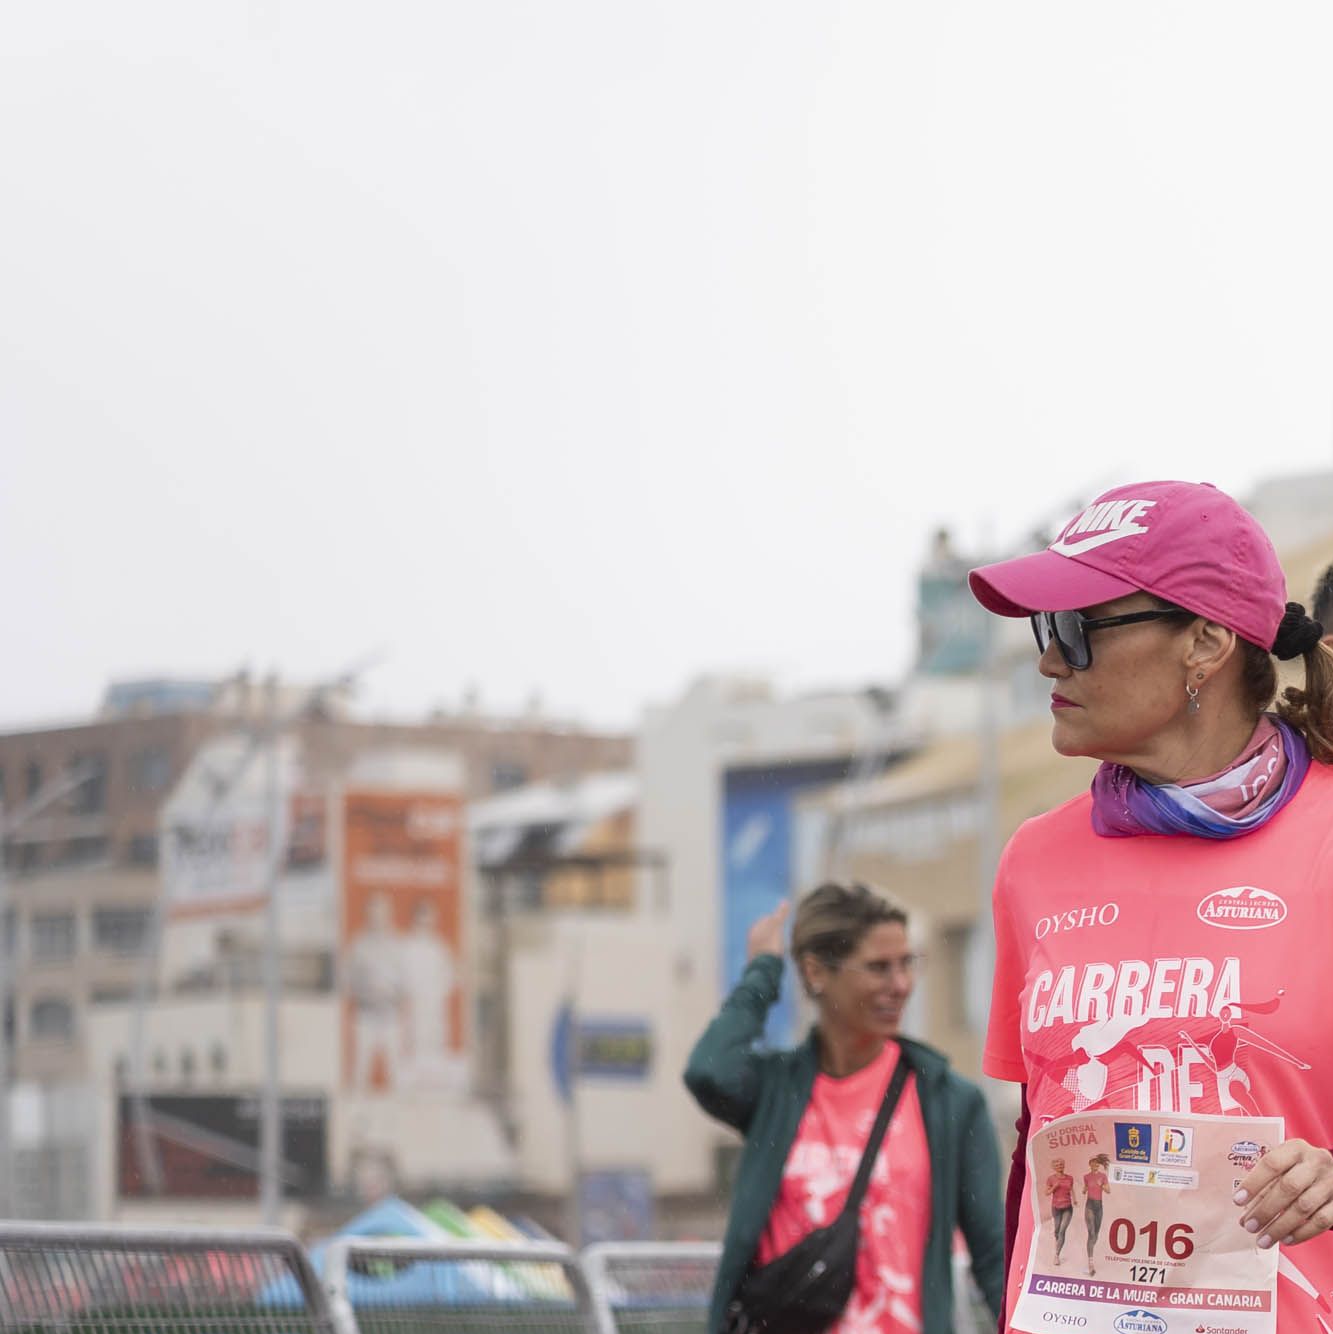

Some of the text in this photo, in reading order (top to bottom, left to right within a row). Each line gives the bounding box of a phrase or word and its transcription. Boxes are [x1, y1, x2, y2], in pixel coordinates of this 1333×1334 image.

[1065, 499, 1158, 537] NIKE
[1203, 900, 1280, 920] ASTURIANA
[1035, 903, 1119, 939] OYSHO
[1027, 957, 1242, 1032] CARRERA
[1059, 1124, 1096, 1136] DORSAL
[1049, 1132, 1098, 1149] SUMA
[1109, 1218, 1194, 1260] 016
[1130, 1266, 1166, 1284] 1271
[1036, 1279, 1085, 1297] CARRERA
[1089, 1284, 1103, 1298] DE
[1107, 1287, 1120, 1300] LA
[1123, 1288, 1158, 1304] MUJER
[1169, 1295, 1203, 1306] GRAN
[1207, 1294, 1262, 1308] CANARIA
[1043, 1311, 1087, 1328] OYSHO
[1117, 1319, 1163, 1332] ASTURIANA
